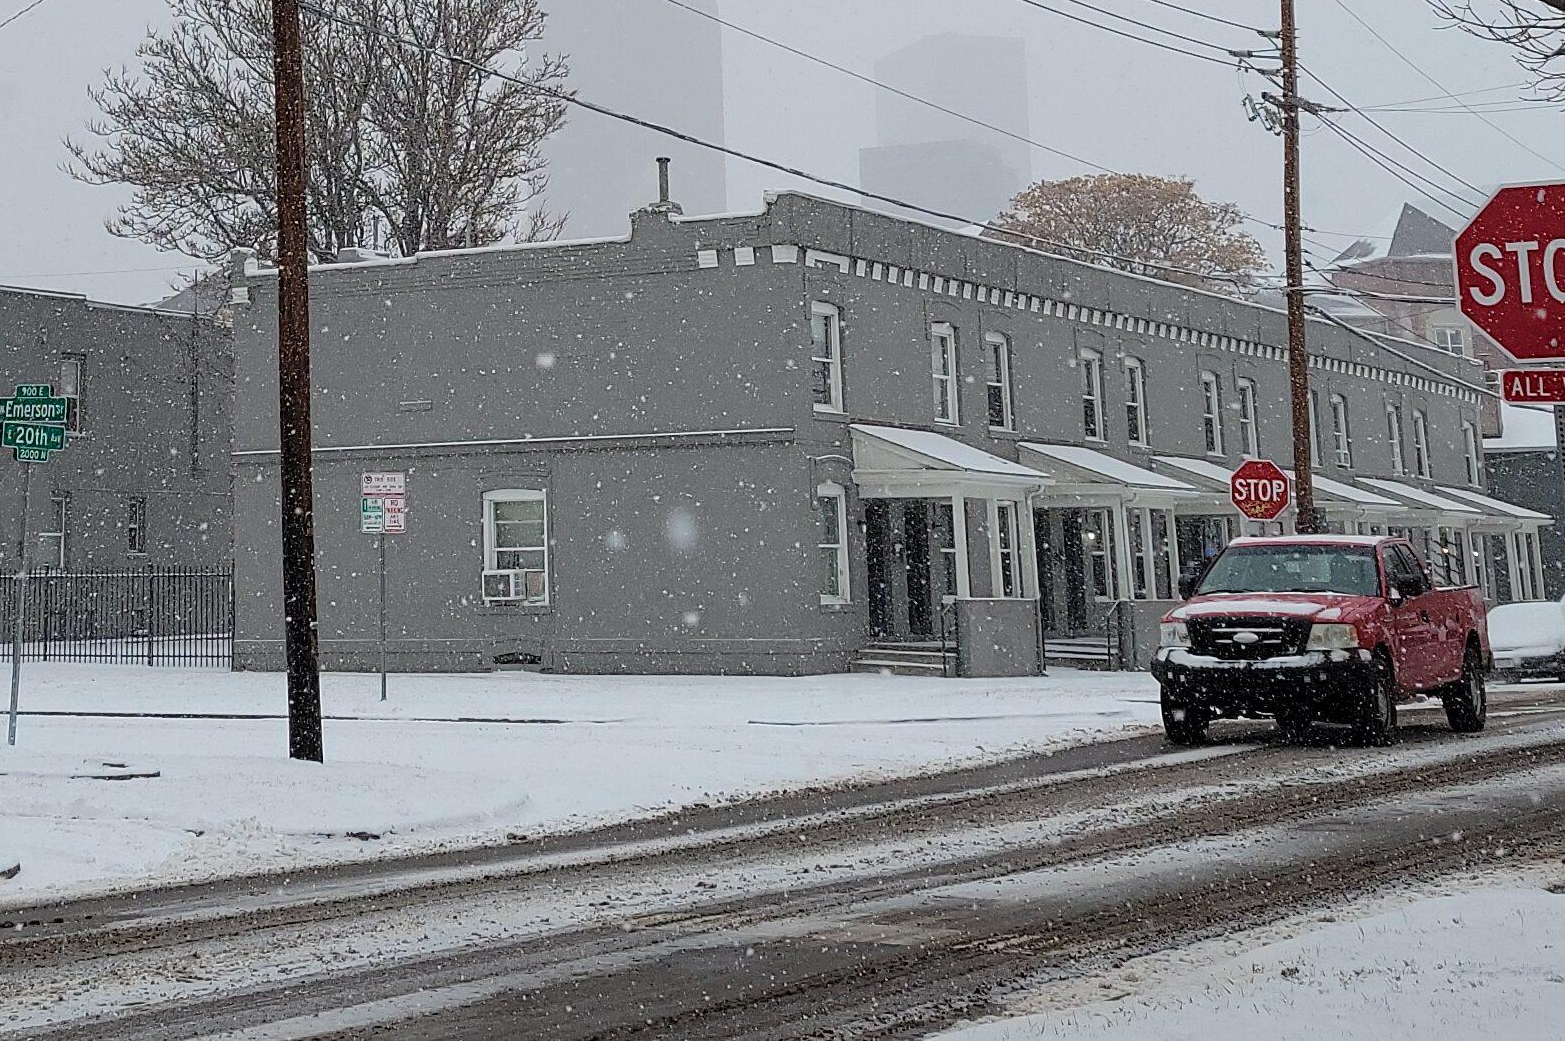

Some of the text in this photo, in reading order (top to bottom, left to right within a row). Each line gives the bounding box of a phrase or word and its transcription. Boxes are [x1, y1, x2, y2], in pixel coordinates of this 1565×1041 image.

[21, 386, 45, 396] 900 E
[1511, 376, 1551, 397] ALL
[5, 400, 55, 418] Emerson
[15, 426, 48, 446] 20th
[19, 449, 39, 460] 2000
[1234, 478, 1285, 502] STOP
